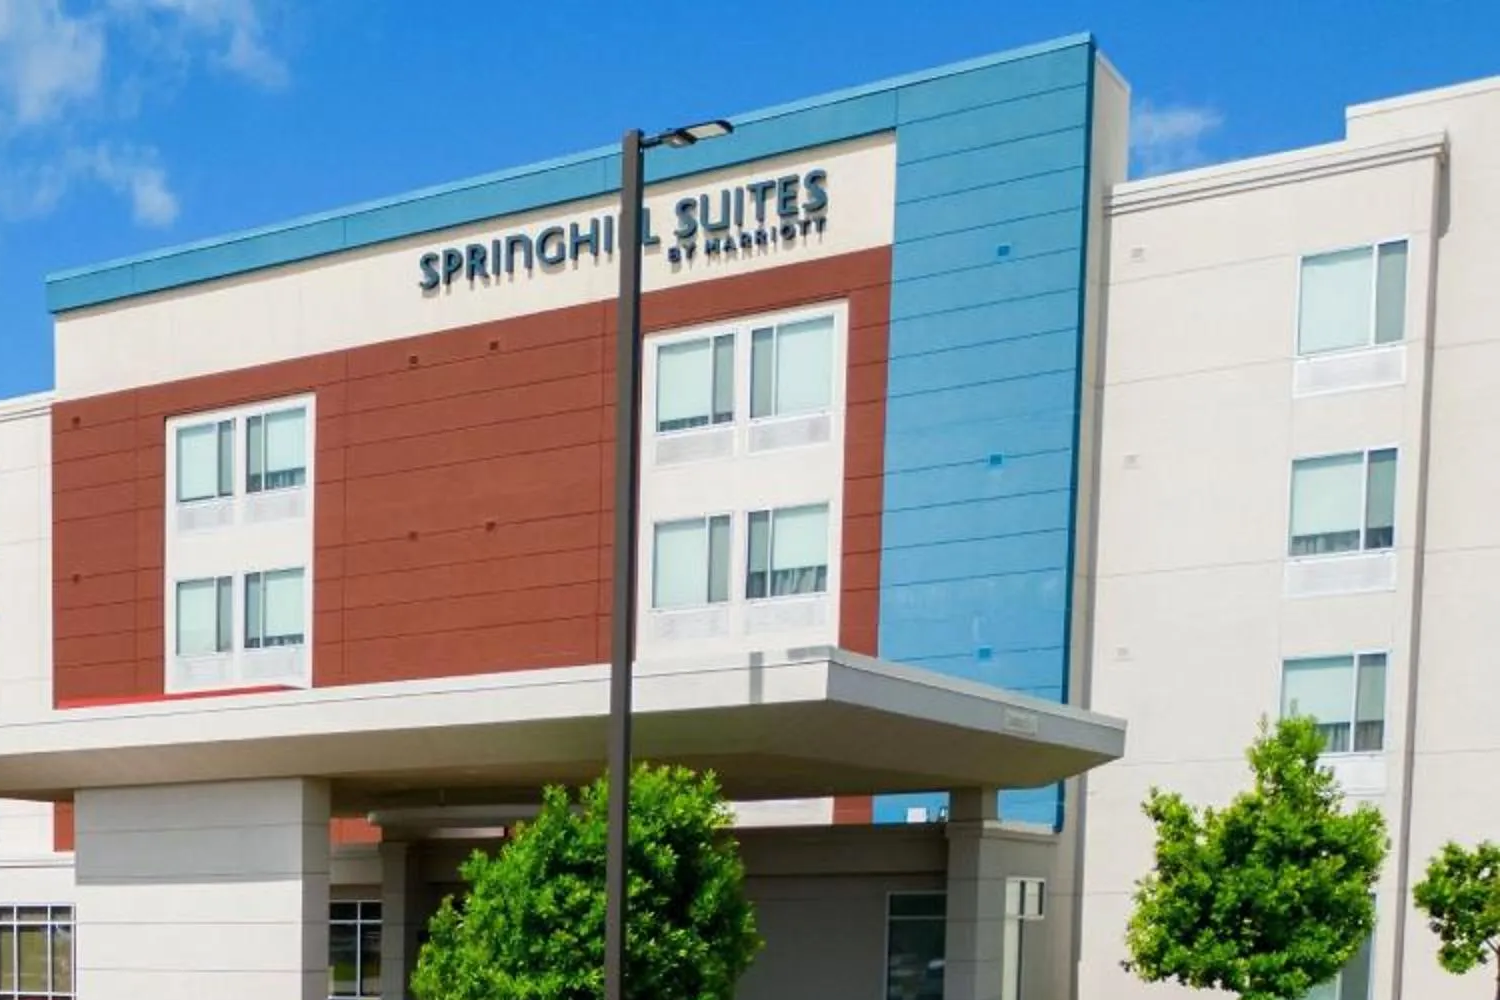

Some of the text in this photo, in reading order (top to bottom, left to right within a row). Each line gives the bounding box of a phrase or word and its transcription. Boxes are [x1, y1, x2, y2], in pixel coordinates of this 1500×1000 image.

[419, 169, 828, 290] SPRINGHIL SUITES
[667, 216, 827, 263] BY MARRIOTT
